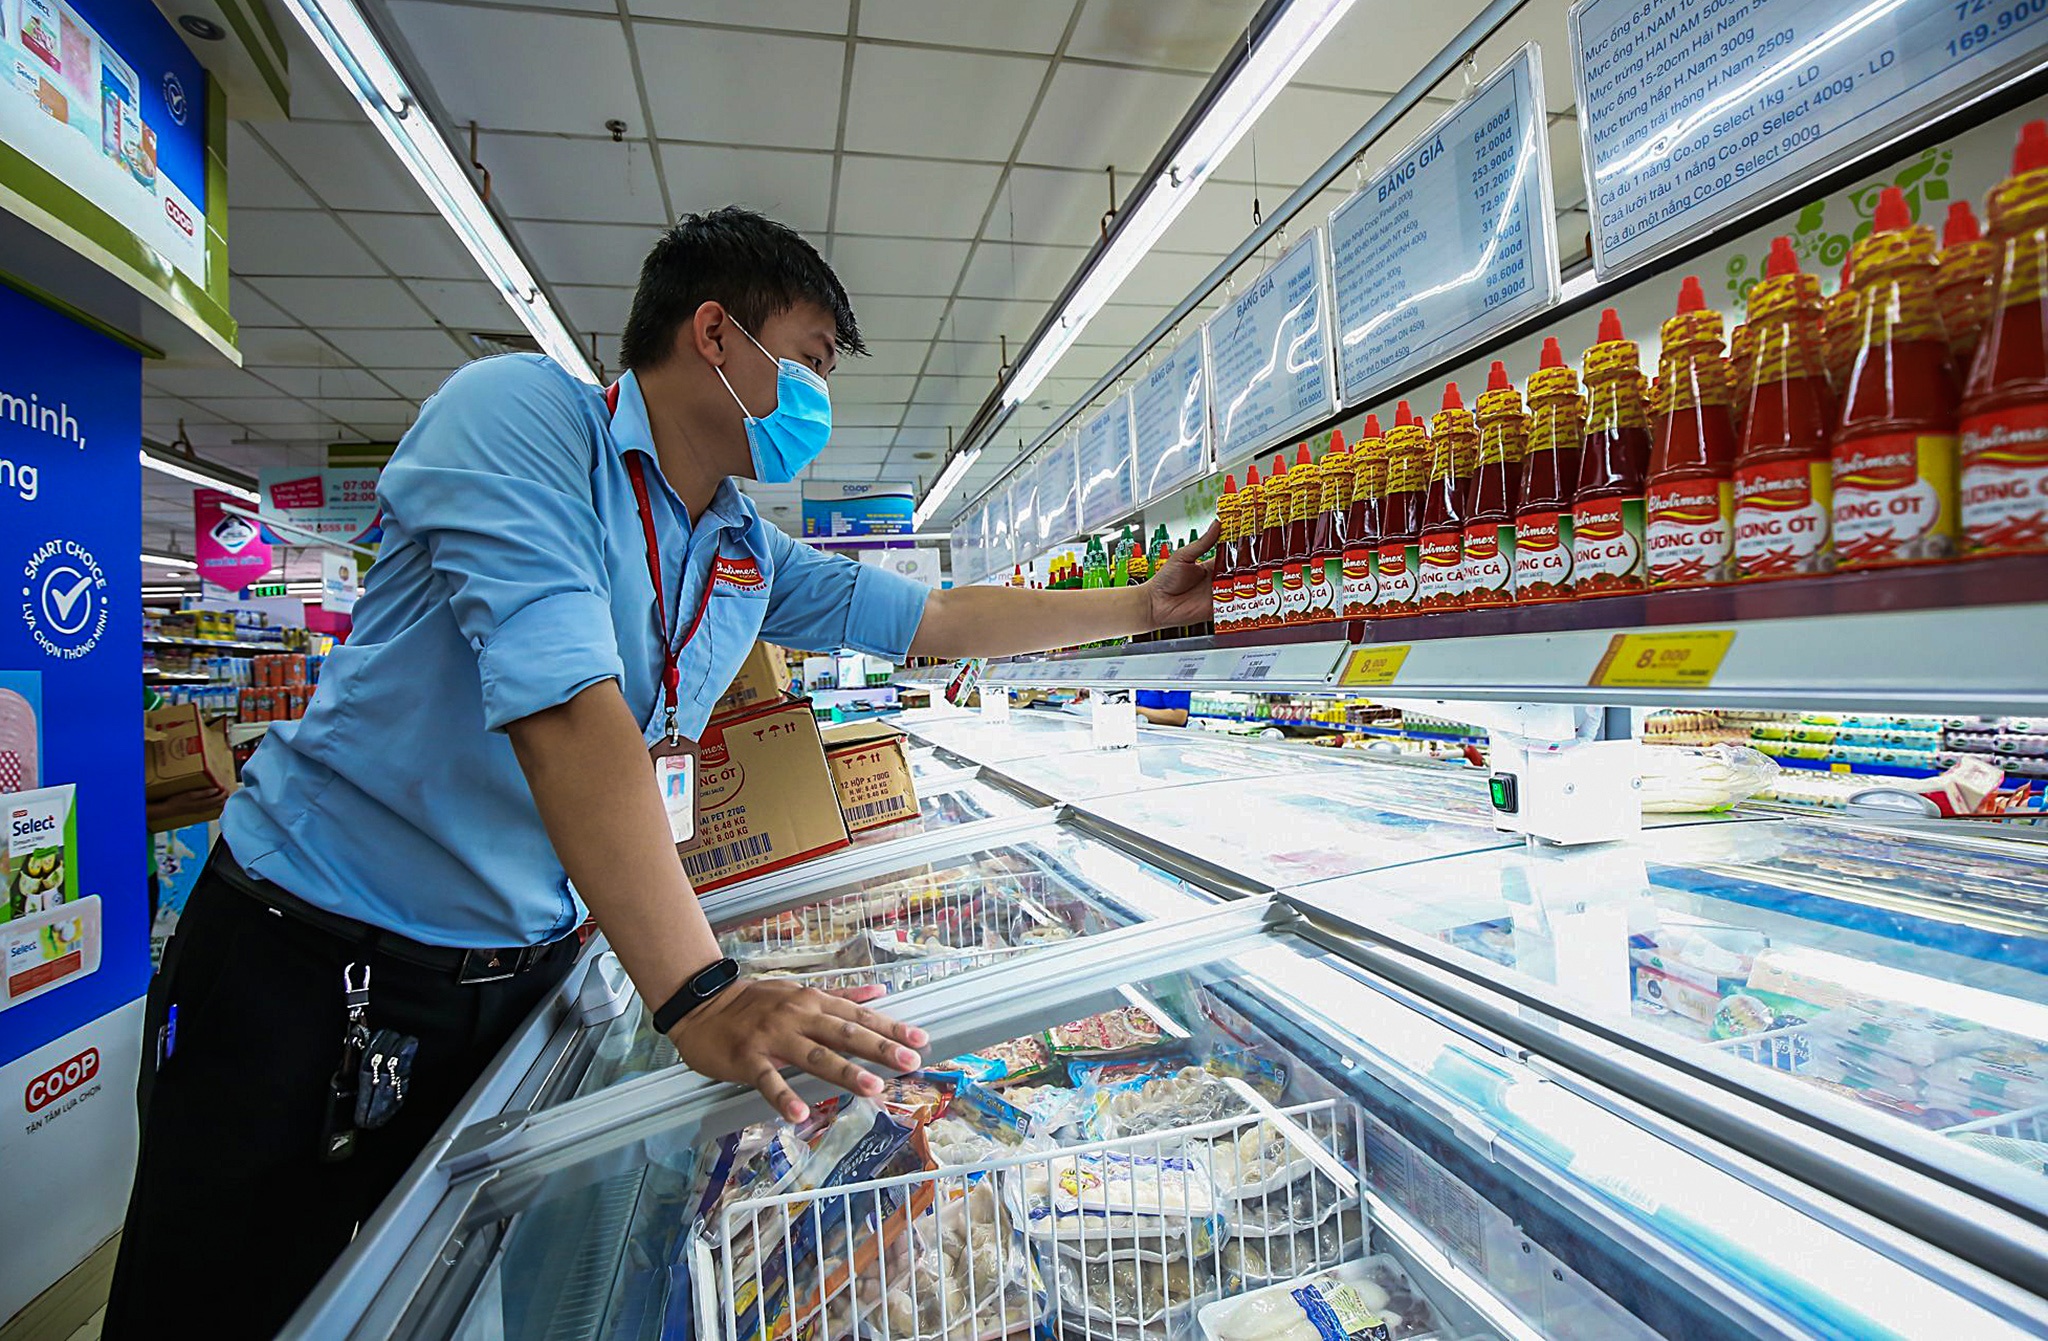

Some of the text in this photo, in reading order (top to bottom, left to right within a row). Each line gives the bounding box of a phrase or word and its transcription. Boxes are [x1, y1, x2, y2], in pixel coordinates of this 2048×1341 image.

[1639, 49, 1690, 87] 15-20cm
[1717, 6, 1749, 34] Nam
[1670, 18, 1701, 48] NAM
[1674, 53, 1717, 90] H.Nam
[1720, 26, 1756, 58] 300g
[1707, 55, 1754, 91] H.Nam
[1757, 27, 1795, 59] 250g
[1673, 134, 1710, 163] Co.op
[1712, 107, 1755, 138] Select
[1758, 87, 1785, 112] 1kg
[1797, 63, 1820, 88] LD
[1718, 128, 1759, 160] Co.op
[1762, 101, 1810, 136] Select
[1812, 75, 1855, 107] 400g
[1869, 50, 1896, 75] LD
[1419, 135, 1445, 168] GIÁ
[1693, 172, 1732, 200] Co.op
[1735, 146, 1780, 178] Select
[1782, 123, 1821, 153] 900g
[24, 539, 108, 590] SMART CHOICE
[1543, 553, 1563, 568] CÀ
[1606, 542, 1629, 558] CÀ
[92, 608, 109, 641] MINH
[12, 815, 56, 837] Select
[711, 805, 746, 823] PET 270G
[713, 816, 746, 833] 6.48 KG
[716, 825, 749, 842] 8.00 KG
[29, 1052, 97, 1107] COOP
